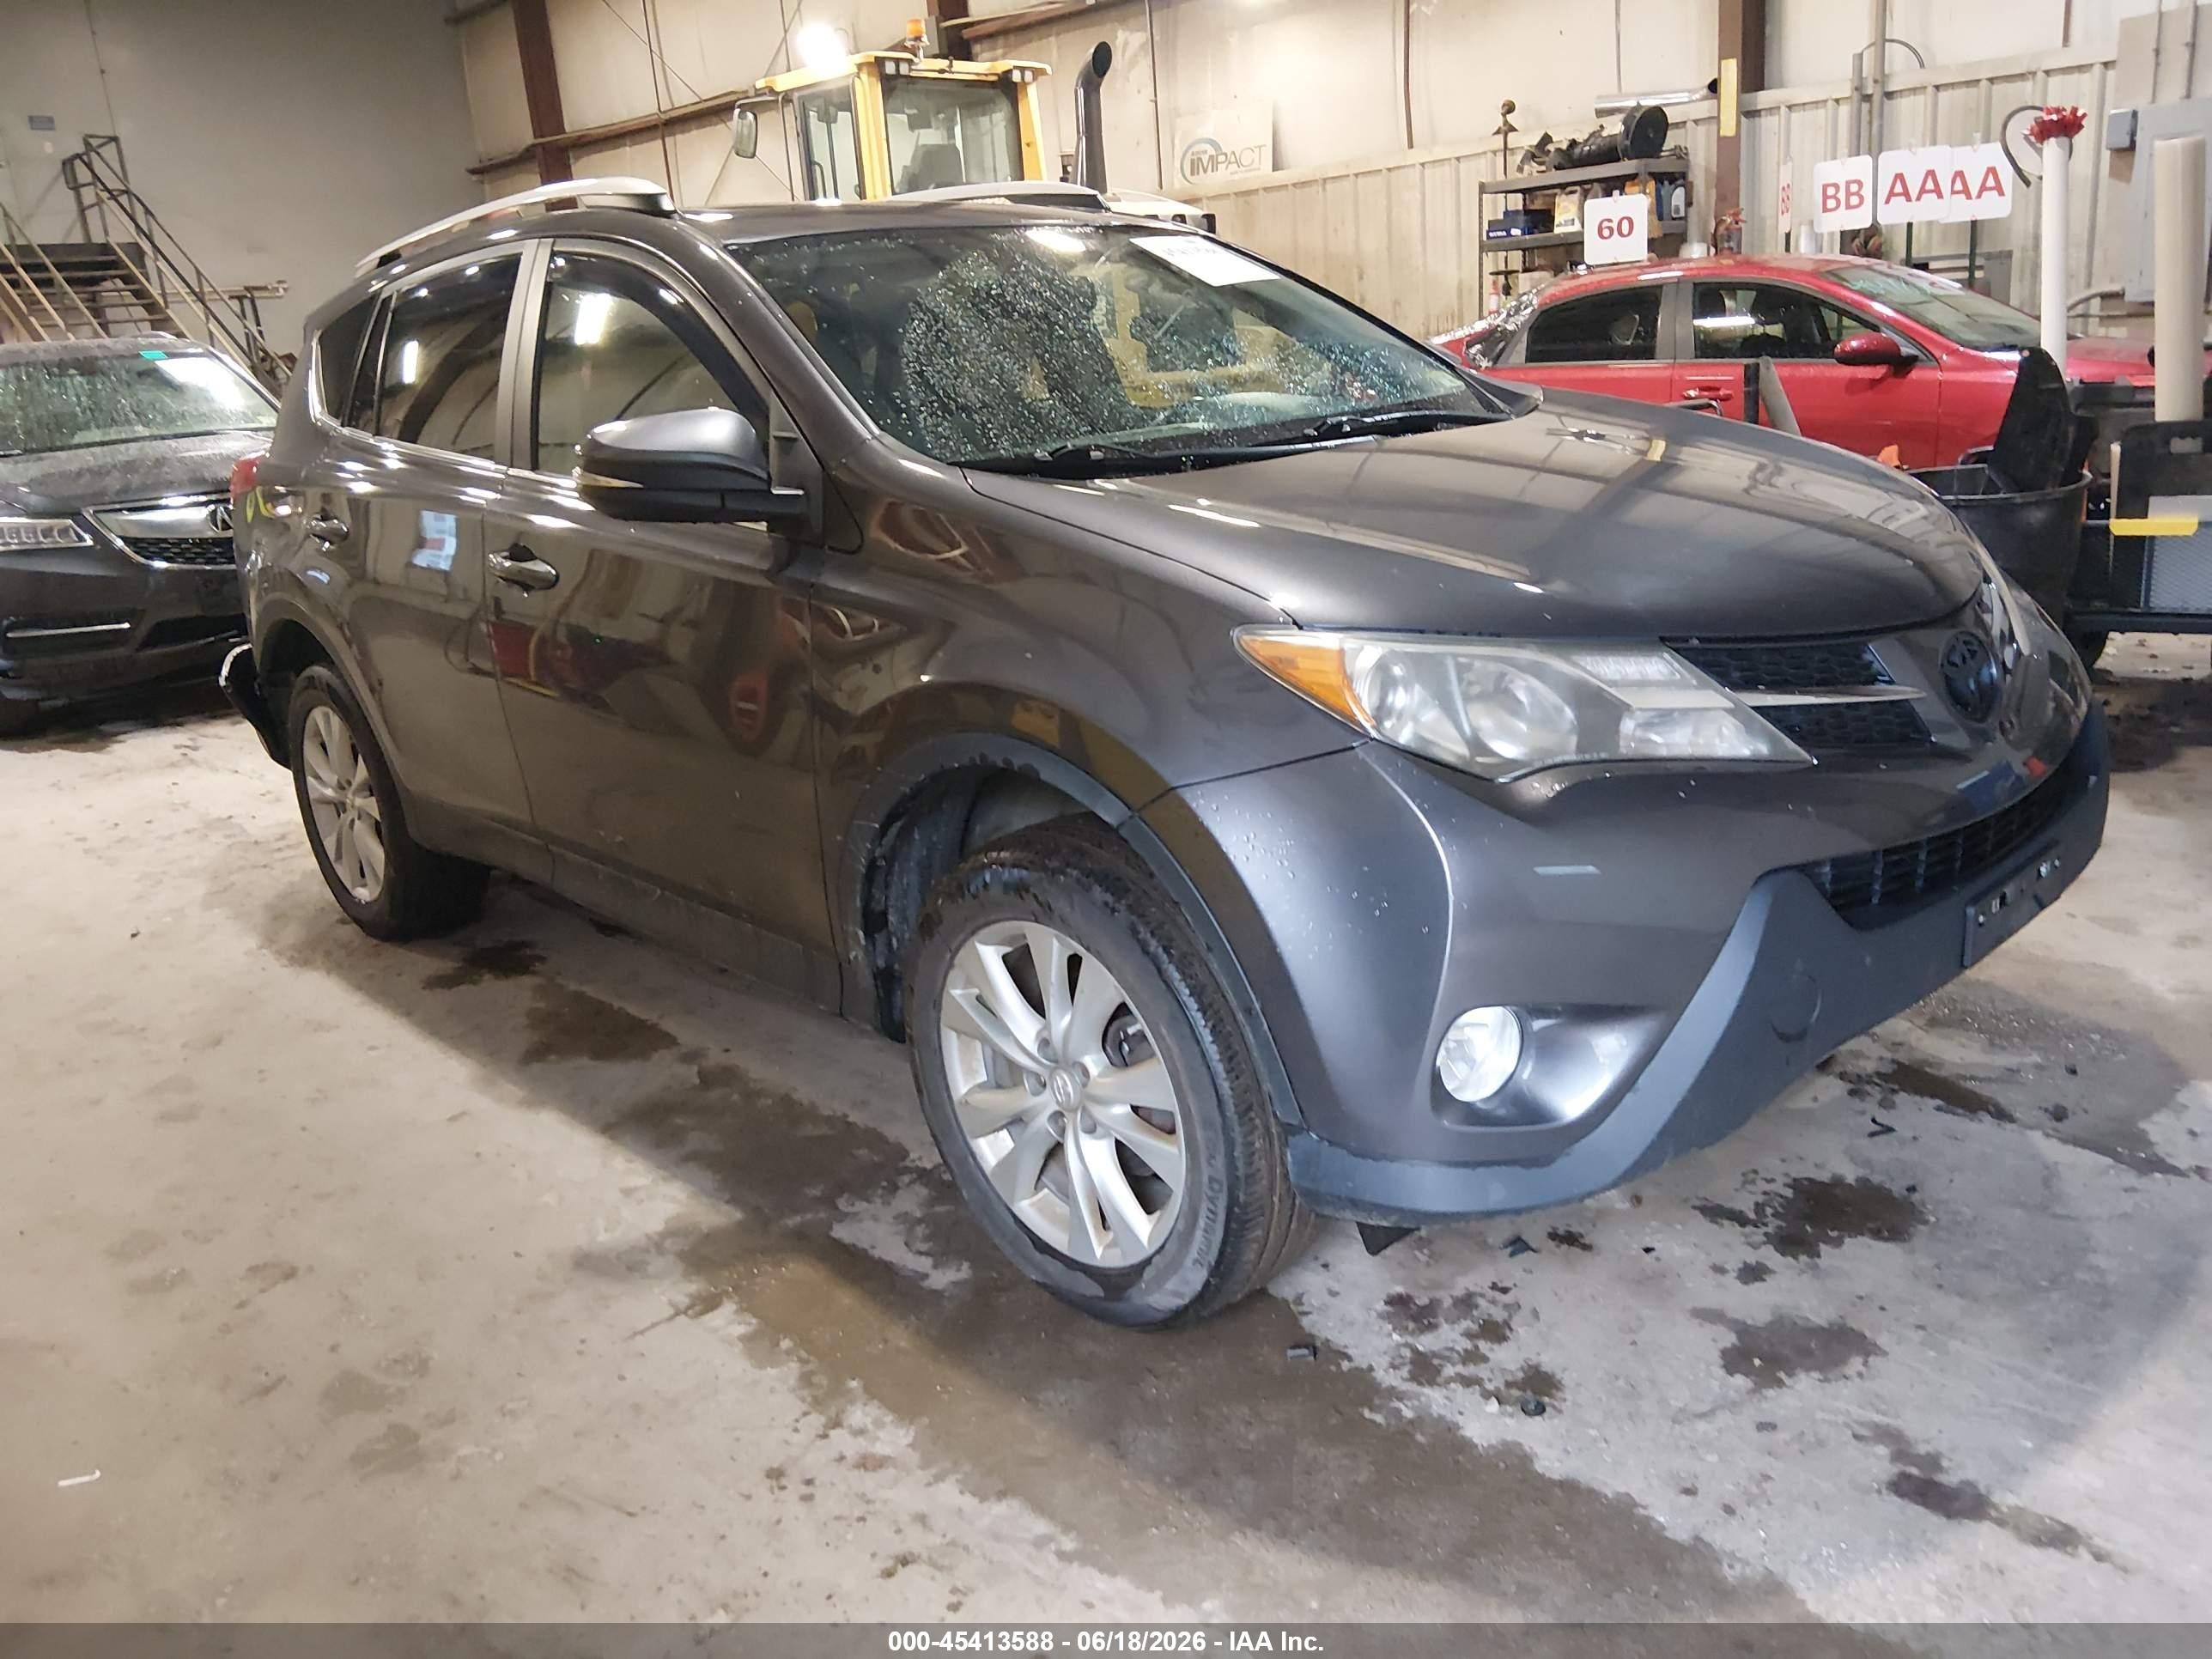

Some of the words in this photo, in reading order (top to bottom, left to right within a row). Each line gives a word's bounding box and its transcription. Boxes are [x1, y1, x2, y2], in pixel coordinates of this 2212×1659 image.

[1821, 179, 1865, 213] BB
[1884, 169, 1944, 204] AA
[1597, 216, 1634, 240] 60
